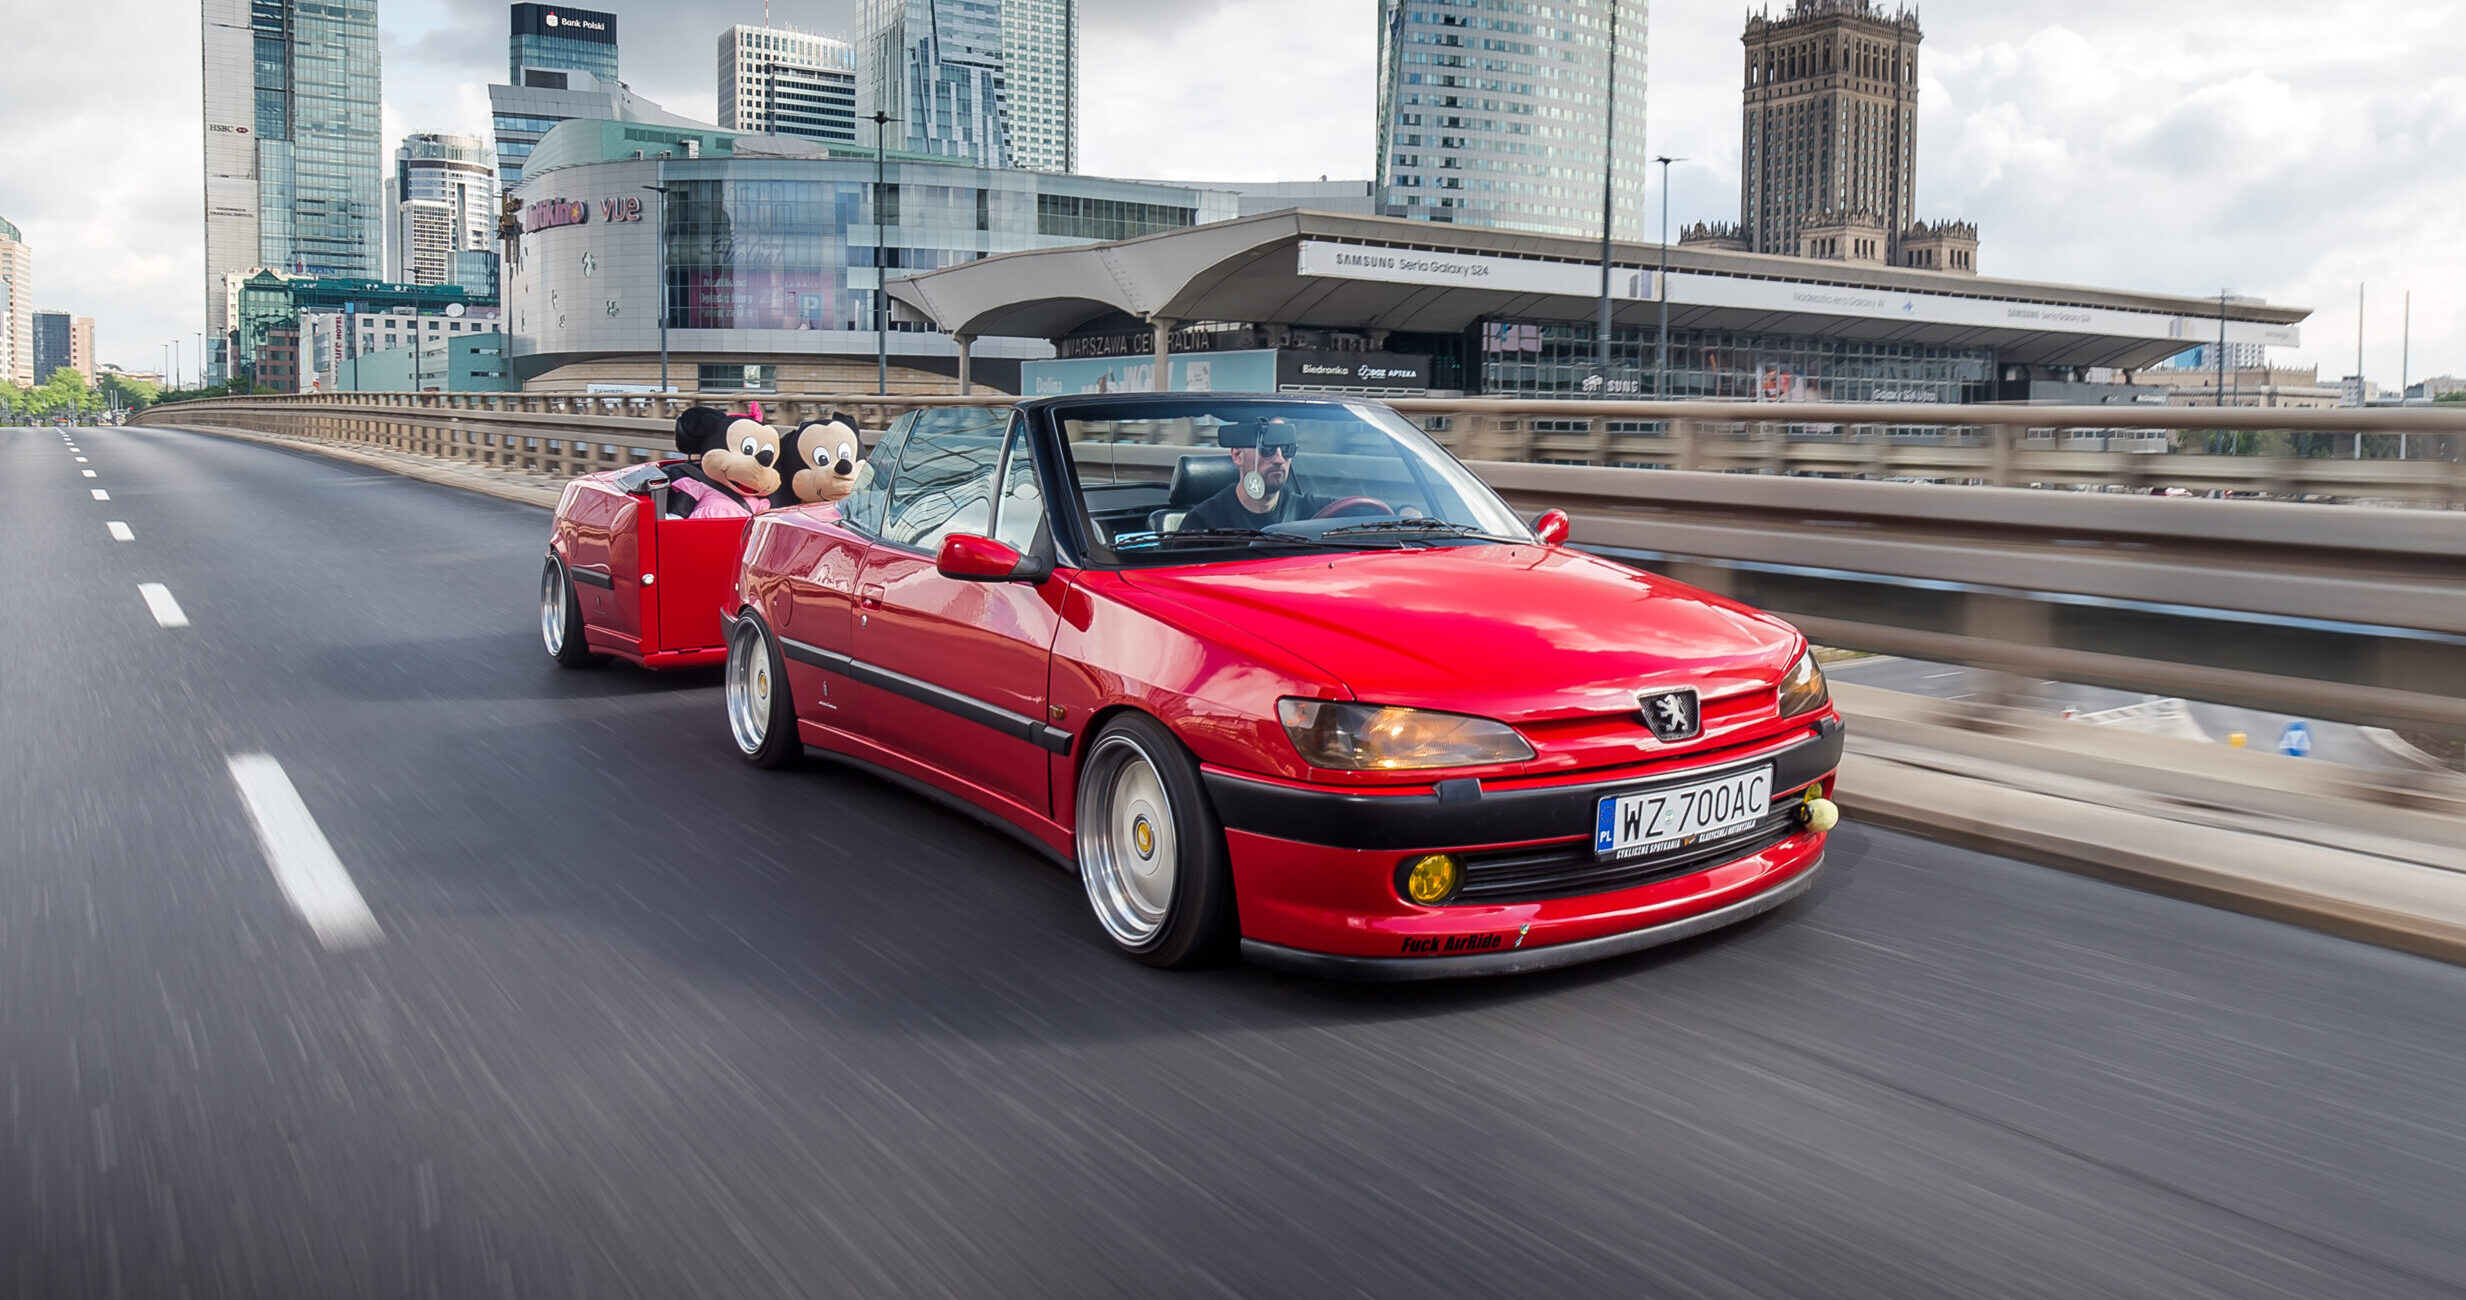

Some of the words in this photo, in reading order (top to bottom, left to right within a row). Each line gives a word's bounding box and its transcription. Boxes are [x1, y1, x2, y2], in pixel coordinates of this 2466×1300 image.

[561, 18, 581, 27] Bank
[583, 20, 605, 30] Polski
[209, 124, 234, 132] HSBC
[600, 197, 640, 221] vue
[1336, 253, 1395, 268] SAMSUNG
[1400, 259, 1428, 271] Seria
[1430, 261, 1469, 277] Galaxy
[1471, 264, 1490, 276] S24
[1067, 334, 1128, 356] WARSZAWA
[1133, 329, 1210, 353] CENRALNA
[1302, 364, 1349, 375] Biedronka
[1387, 369, 1417, 377] APTEKA
[1623, 797, 1666, 842] WZ
[1677, 776, 1764, 832] 700AC
[1599, 830, 1612, 843] PL
[1616, 843, 1650, 859] CYKLICZNE
[1649, 838, 1681, 854] SPOTKANIA
[1401, 936, 1440, 953] Fuck
[1443, 933, 1502, 951] AirRide
